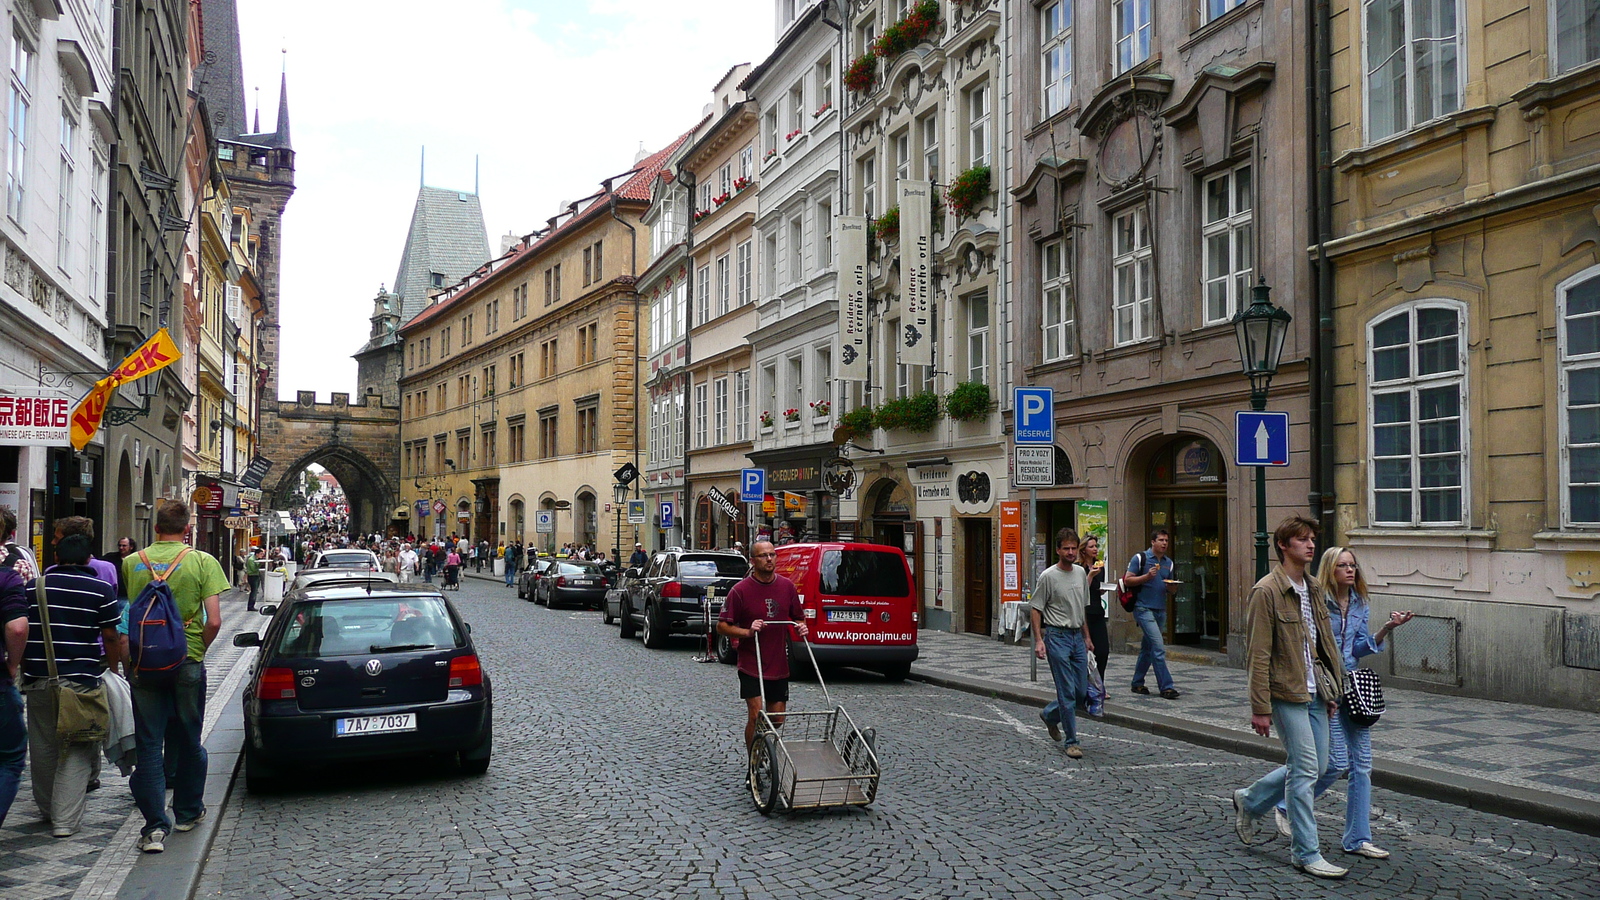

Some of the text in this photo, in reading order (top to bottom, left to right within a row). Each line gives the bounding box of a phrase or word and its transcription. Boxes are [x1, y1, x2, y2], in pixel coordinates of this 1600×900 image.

[918, 235, 927, 259] orla
[855, 265, 863, 286] orla
[918, 318, 927, 326] U
[1023, 394, 1045, 426] P
[1018, 429, 1050, 438] RÉSERVÉ
[920, 469, 948, 479] Residence
[1021, 466, 1049, 474] RESIDENCE
[746, 472, 760, 491] P
[709, 488, 740, 518] ANTIQUE
[663, 505, 670, 520] P
[817, 630, 911, 642] www.kpronajmu.eu
[347, 715, 410, 731] 7A7 7037
